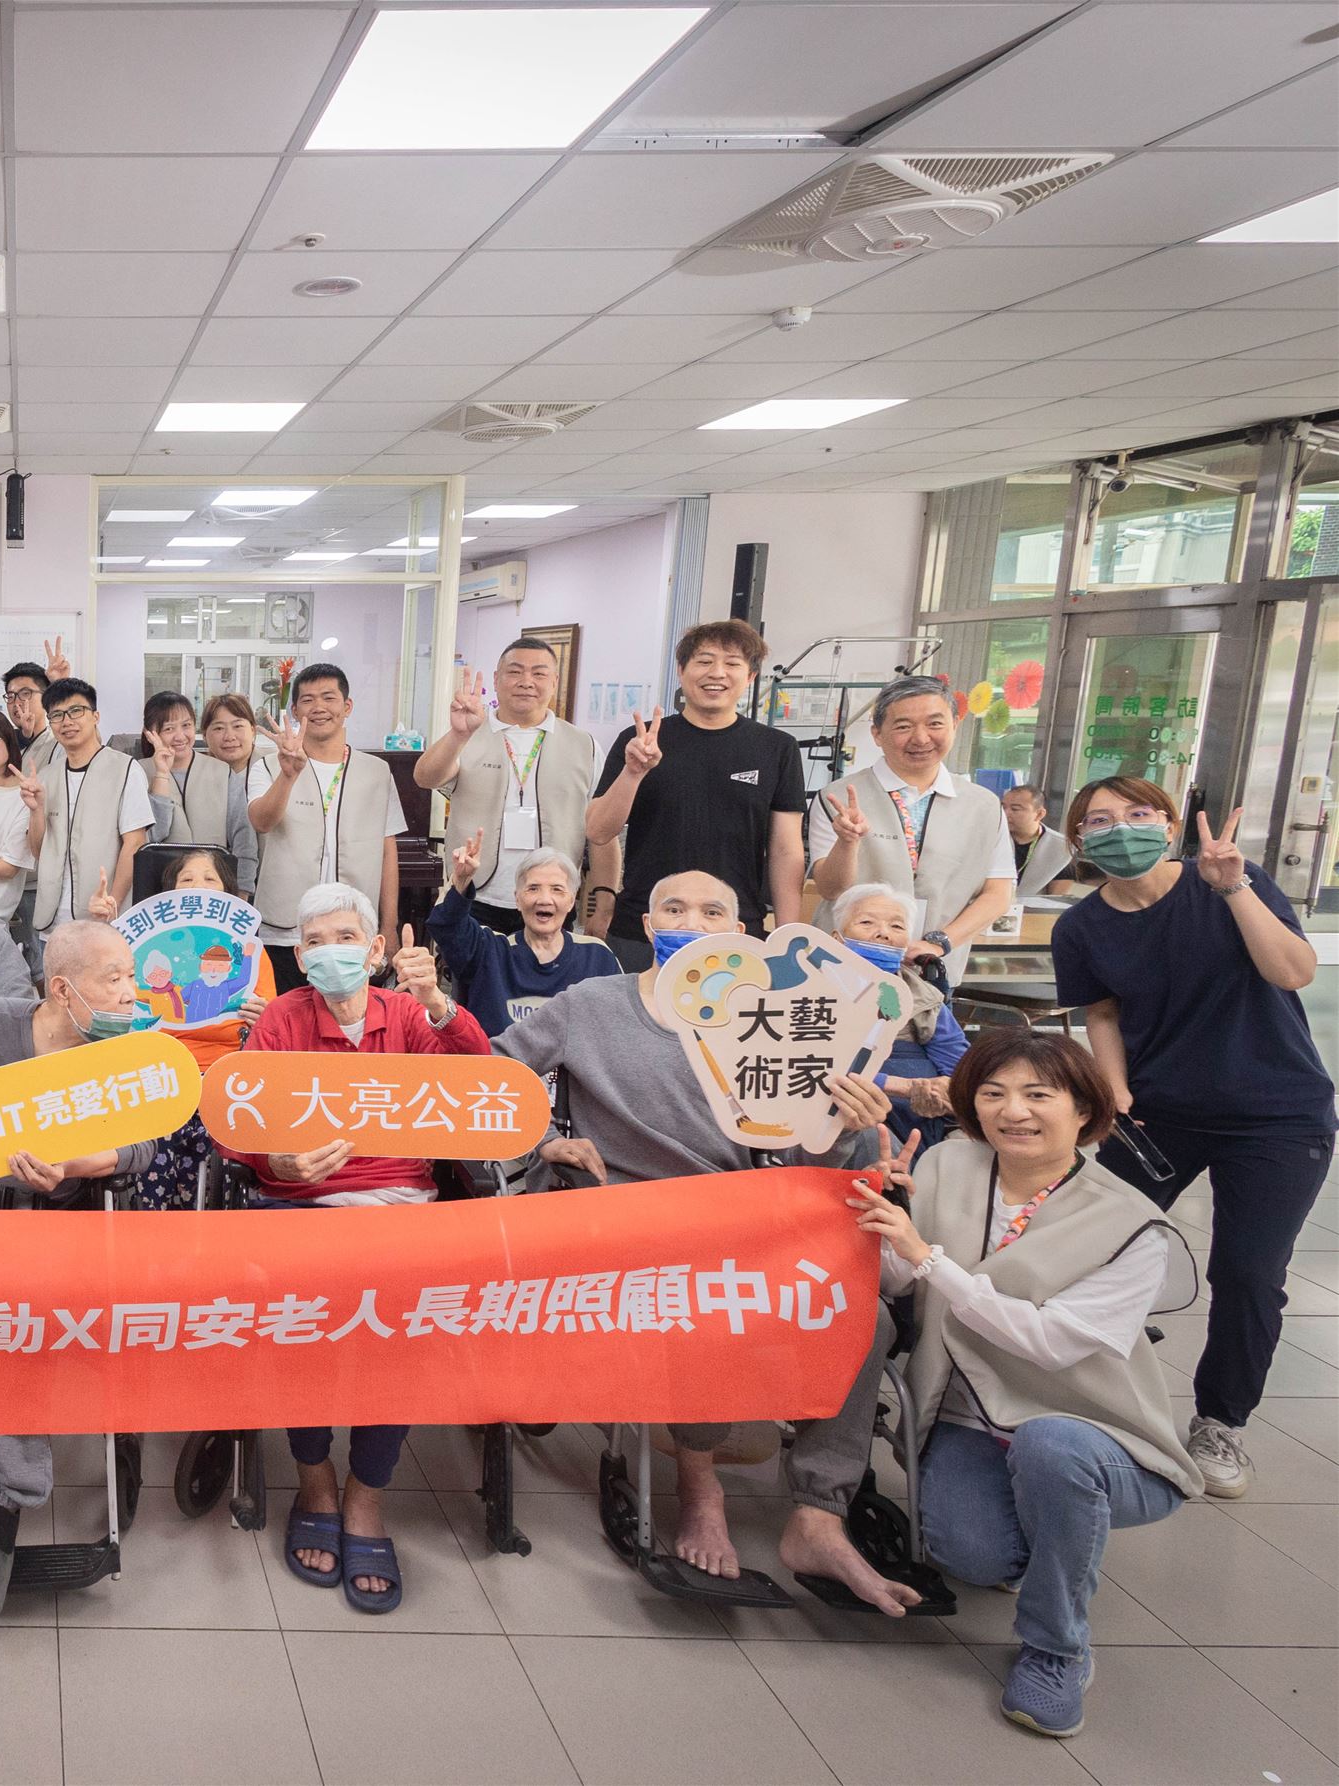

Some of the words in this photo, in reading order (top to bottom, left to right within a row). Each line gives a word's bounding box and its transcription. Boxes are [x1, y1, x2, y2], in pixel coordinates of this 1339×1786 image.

[34, 1061, 180, 1131] 亮愛行動
[289, 1077, 523, 1133] 大亮公益
